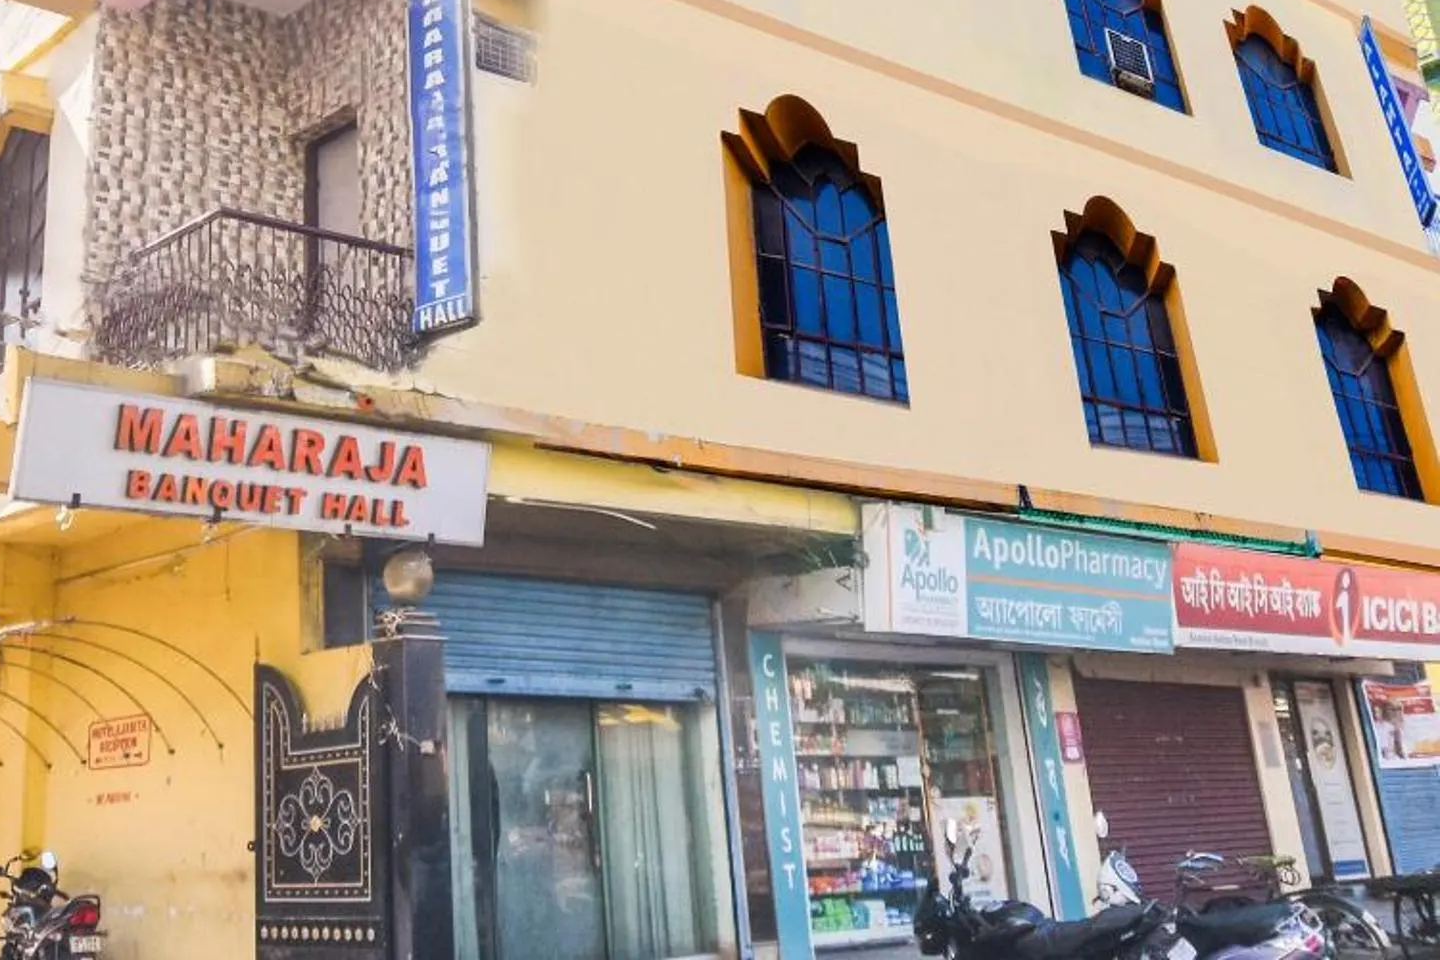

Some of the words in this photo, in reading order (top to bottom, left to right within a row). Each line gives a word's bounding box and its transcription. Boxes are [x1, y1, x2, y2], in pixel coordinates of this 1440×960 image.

[419, 298, 466, 331] HALL
[113, 404, 429, 489] MAHARAJA
[126, 468, 308, 516] BANQUET
[320, 491, 410, 528] HALL
[901, 565, 958, 601] Apollo
[1363, 595, 1420, 634] ICICI
[762, 654, 796, 890] CHEMIST
